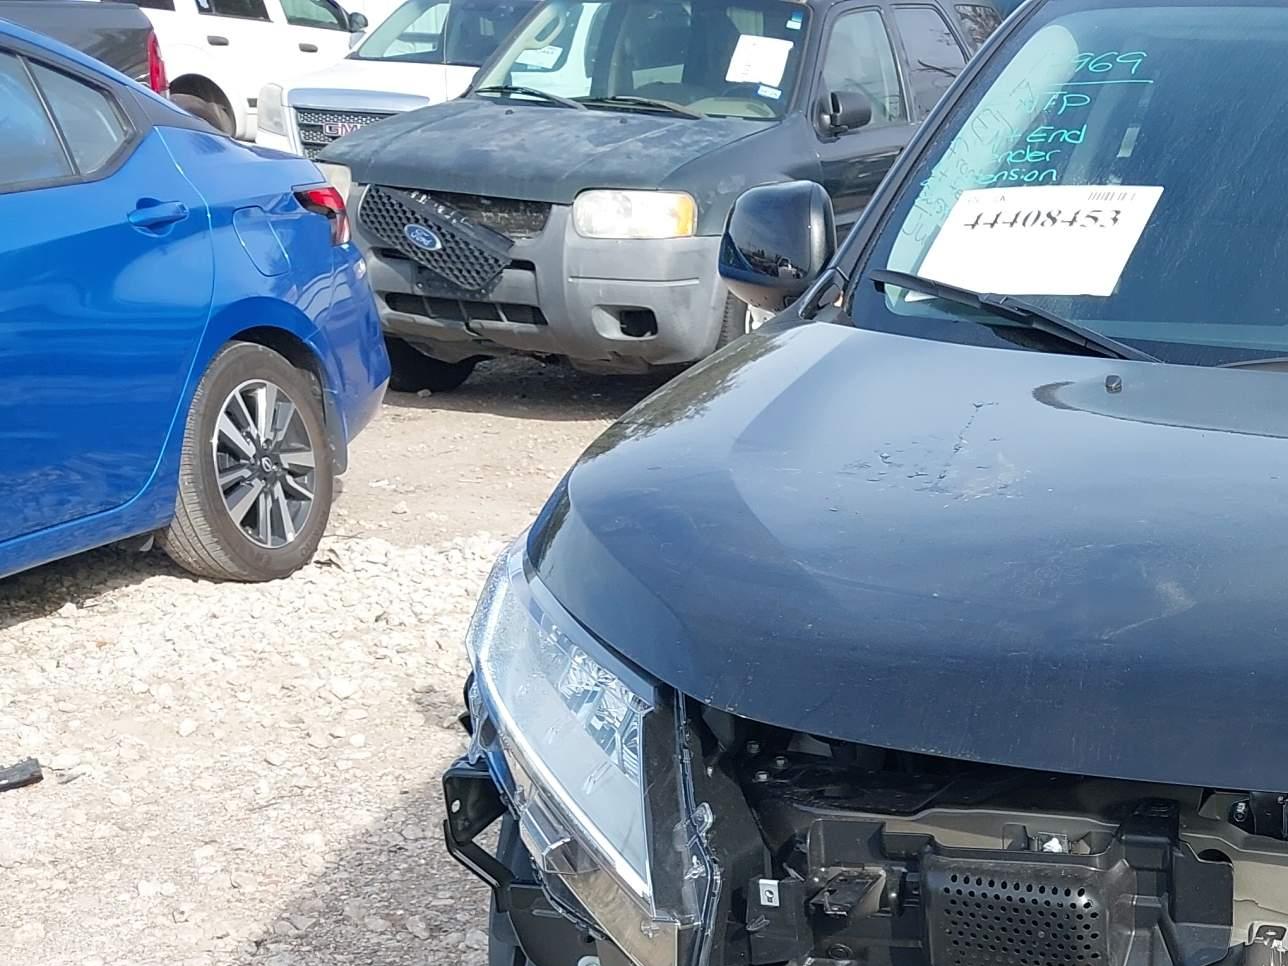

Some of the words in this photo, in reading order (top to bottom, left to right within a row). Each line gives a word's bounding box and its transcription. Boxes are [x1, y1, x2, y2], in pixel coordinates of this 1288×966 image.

[1072, 52, 1147, 74] 969
[322, 122, 362, 137] GM
[1025, 124, 1088, 144] End
[1000, 150, 1061, 163] nder
[410, 228, 433, 244] Ford
